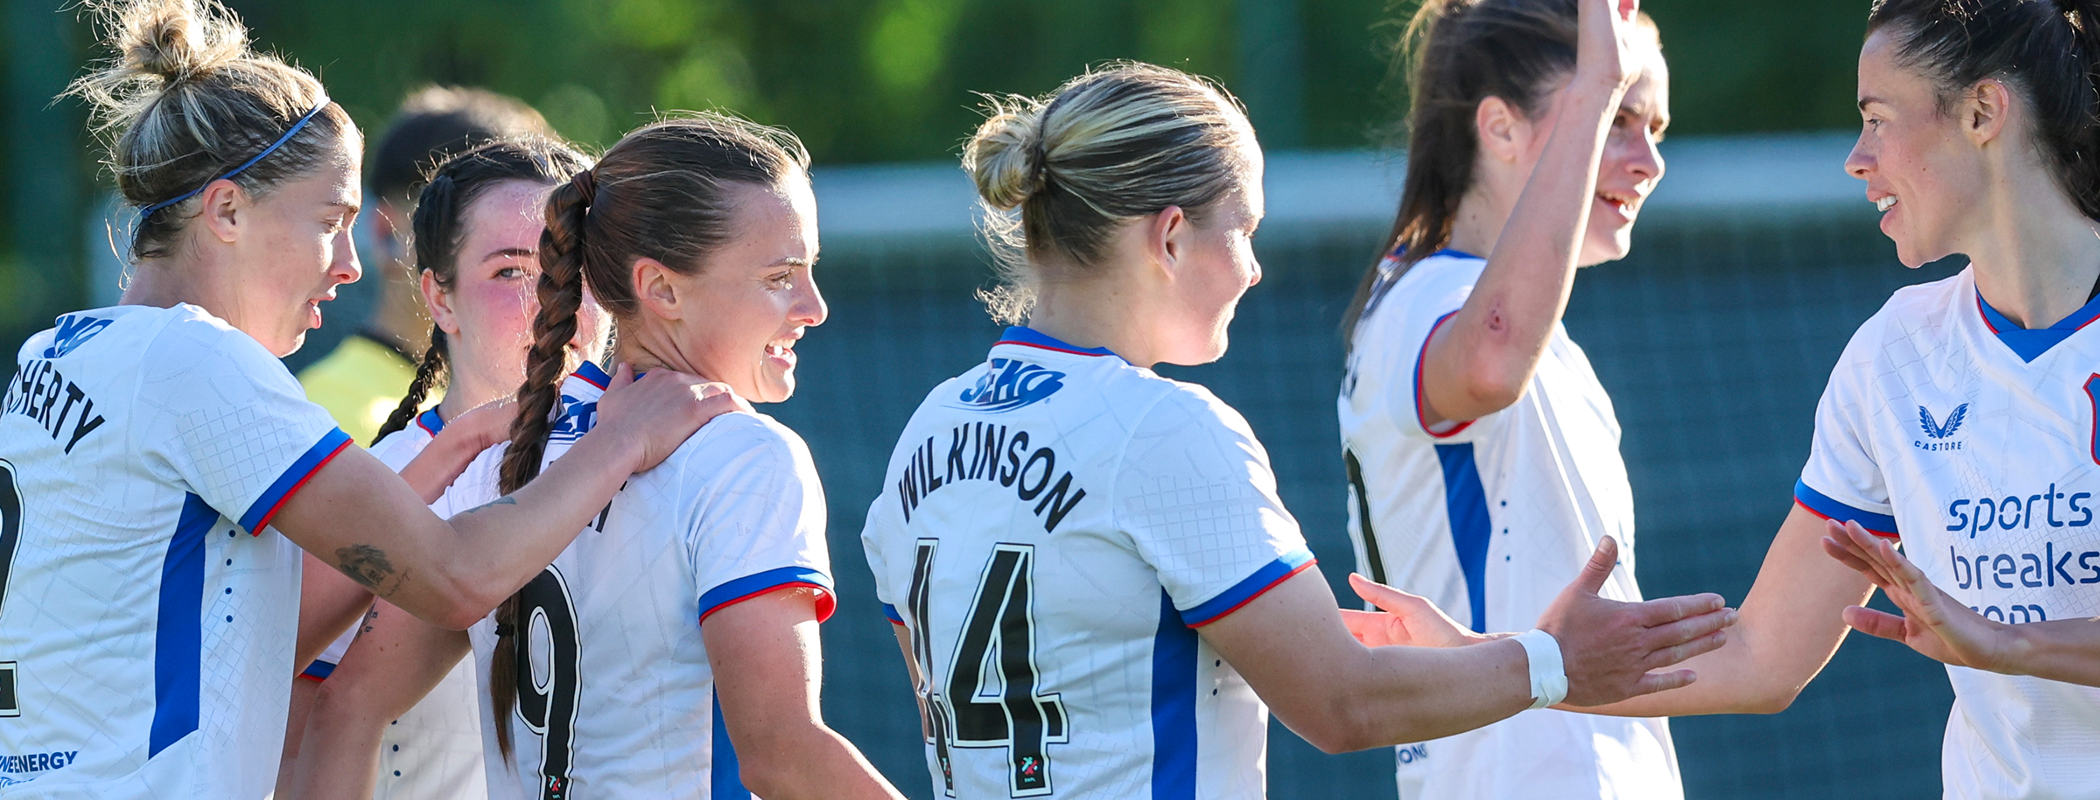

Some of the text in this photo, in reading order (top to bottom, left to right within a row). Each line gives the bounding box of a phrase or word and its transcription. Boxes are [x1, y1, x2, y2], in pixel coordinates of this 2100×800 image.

[1914, 440, 1962, 452] CASTORE
[898, 421, 1087, 534] WILKINSON
[1946, 483, 2093, 539] sports
[1950, 541, 2100, 590] breaks
